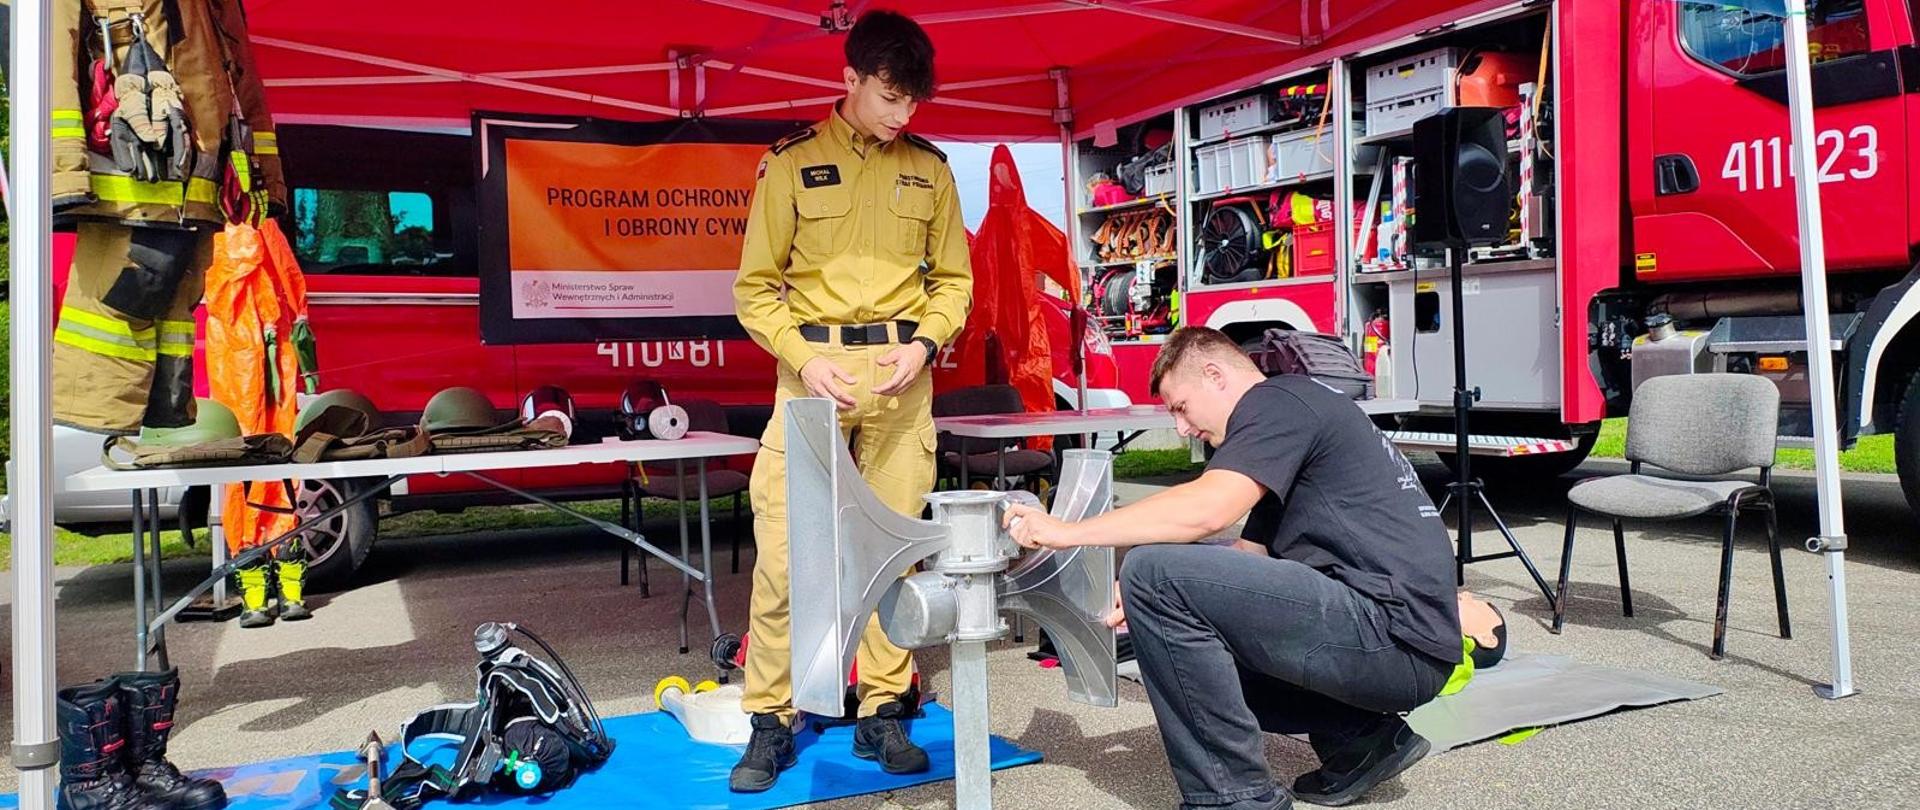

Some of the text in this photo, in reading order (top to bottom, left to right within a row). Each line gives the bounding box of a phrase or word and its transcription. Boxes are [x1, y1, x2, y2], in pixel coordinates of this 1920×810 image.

[1721, 124, 1878, 192] 41123
[547, 187, 751, 208] PROGRAM OCHRONY
[604, 218, 610, 237] I
[616, 217, 700, 237] OBRONY
[551, 282, 634, 293] Ministerstwo Spraw
[552, 292, 616, 302] Wewnętrznych
[621, 292, 674, 302] Administracji
